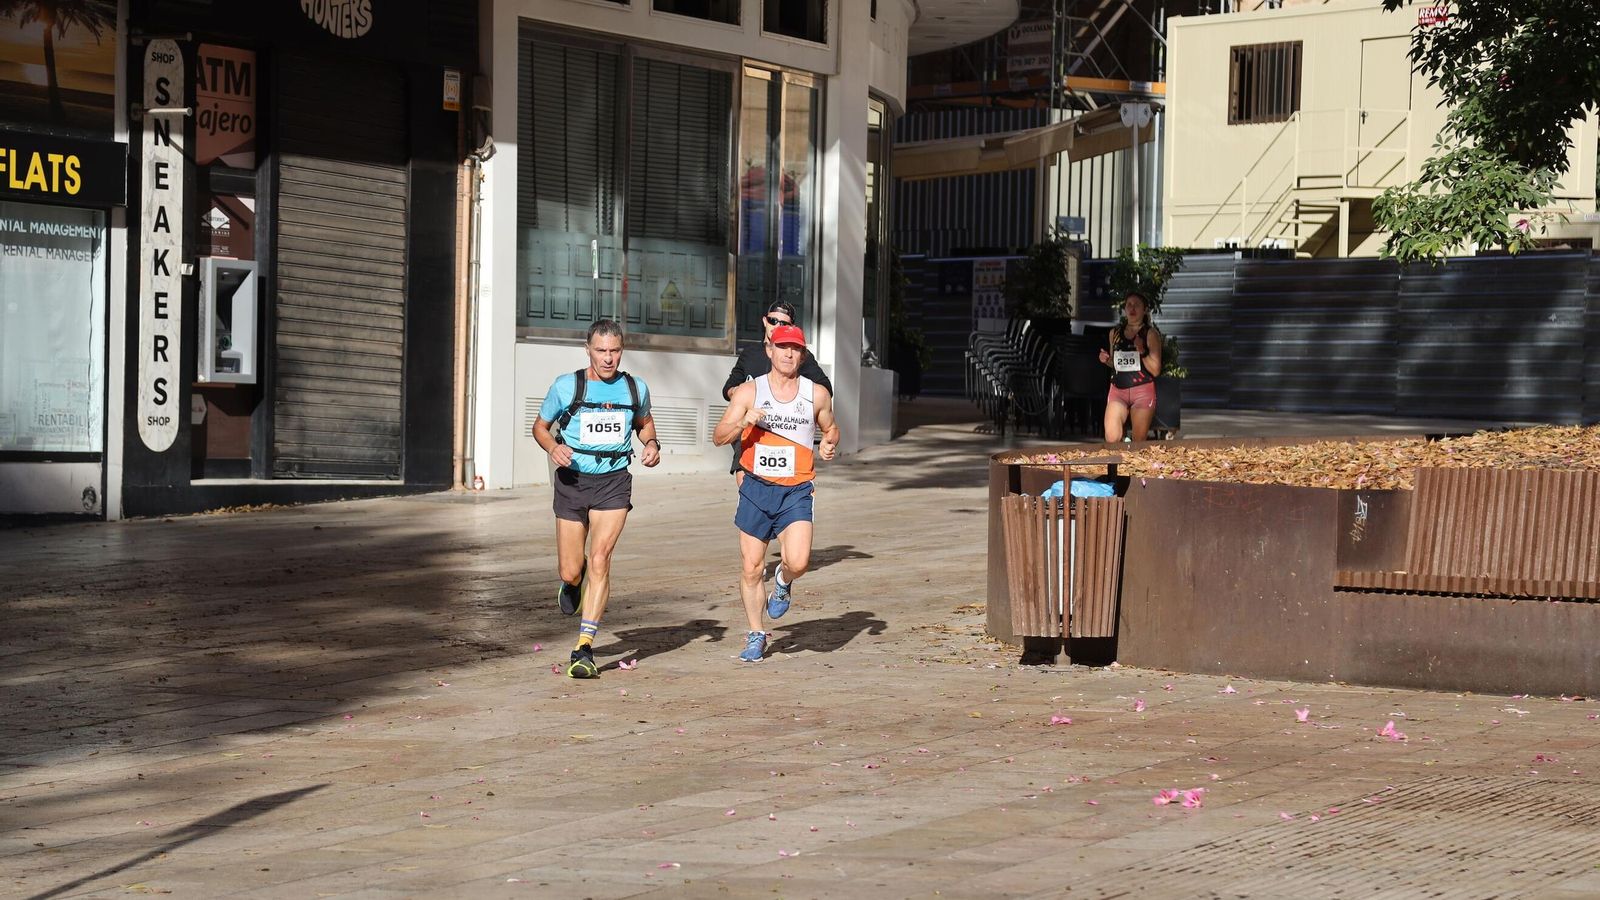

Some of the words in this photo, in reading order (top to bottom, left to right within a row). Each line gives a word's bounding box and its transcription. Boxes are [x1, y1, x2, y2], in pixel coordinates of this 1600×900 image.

[151, 51, 175, 64] SHOP
[196, 102, 252, 136] ajero
[30, 222, 101, 240] MANAGEMENT
[152, 76, 171, 406] SNEAKERS
[1117, 358, 1136, 366] 239
[147, 415, 170, 427] SHOP
[586, 422, 621, 433] 1055
[759, 456, 787, 468] 303
